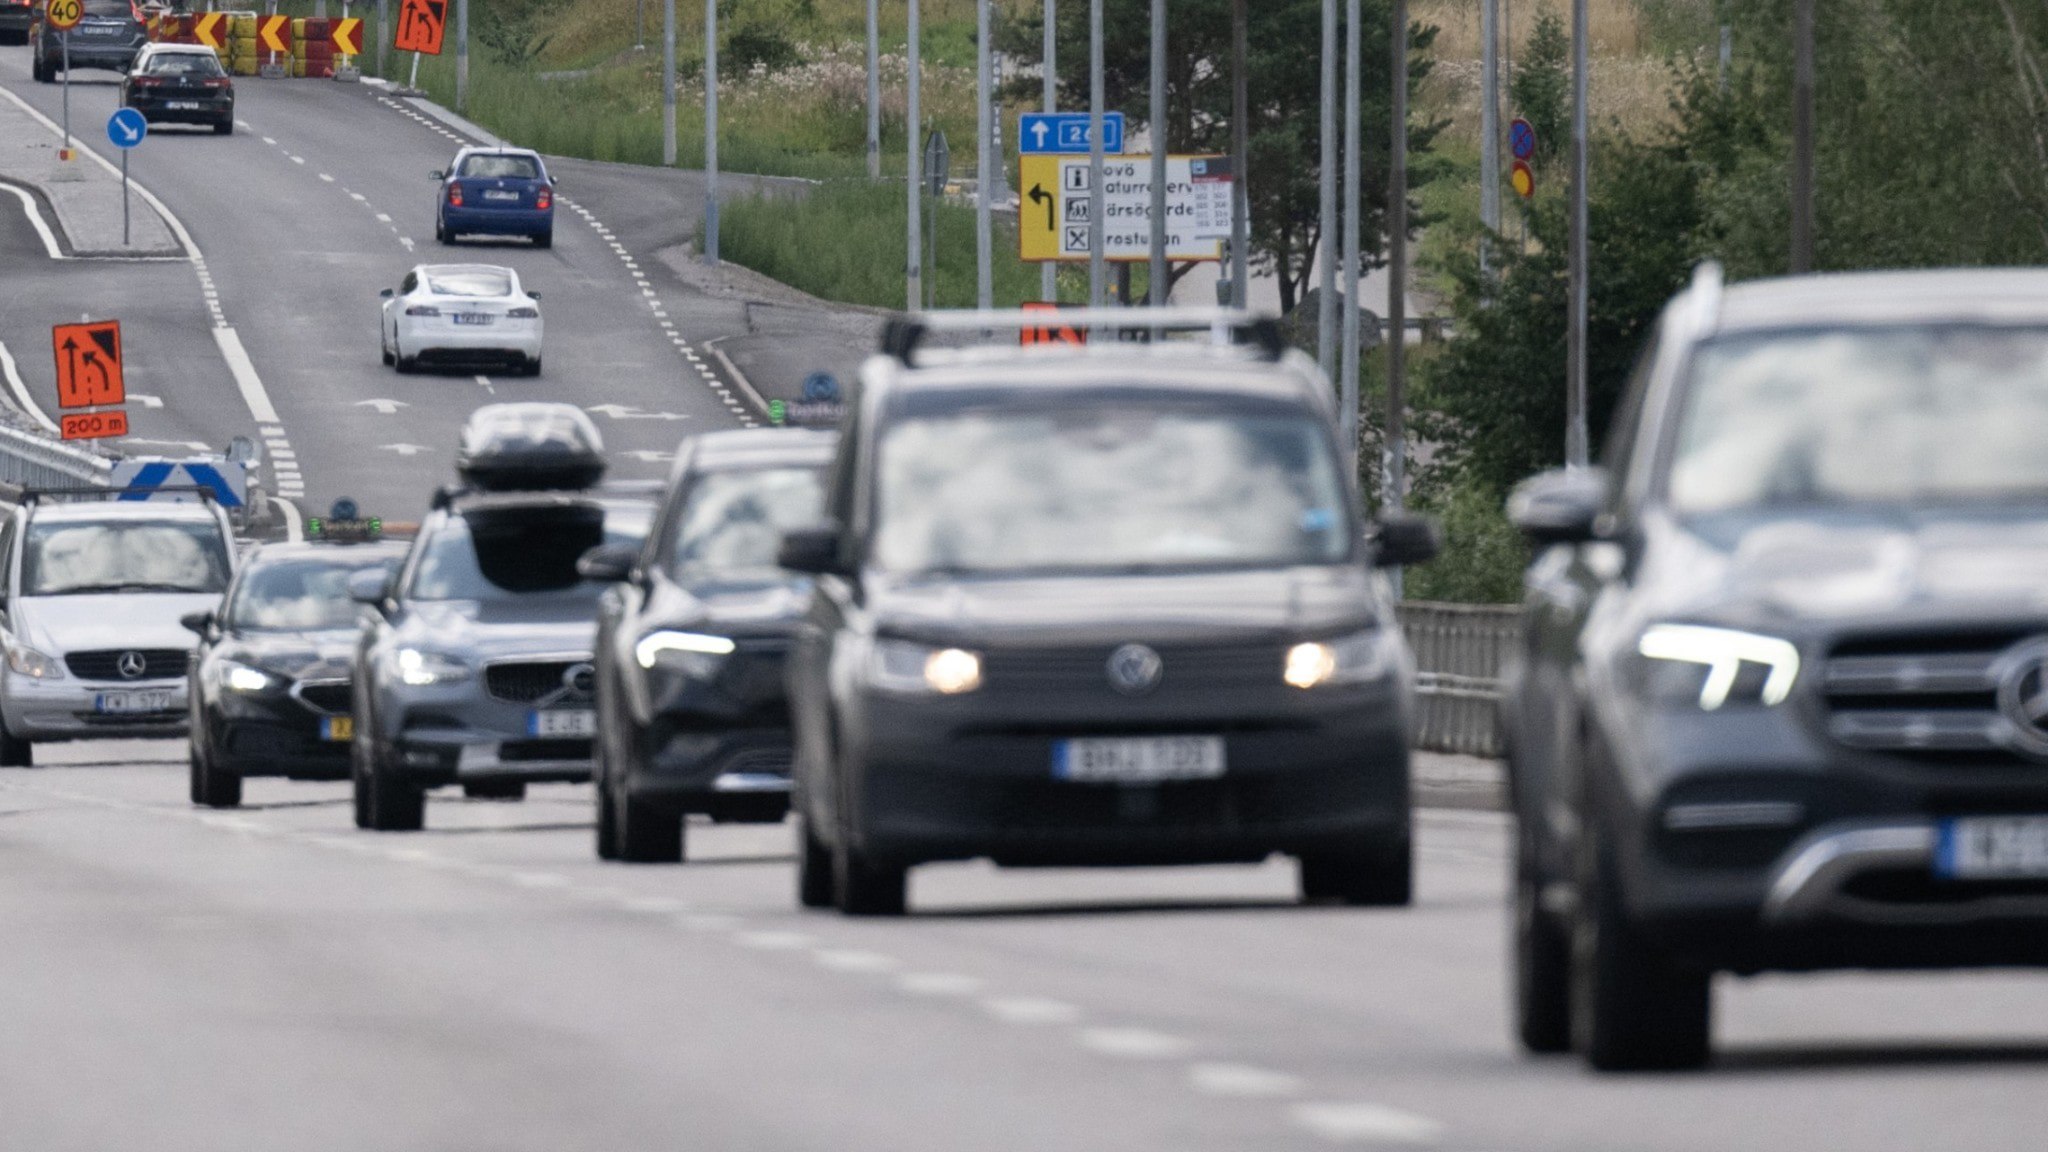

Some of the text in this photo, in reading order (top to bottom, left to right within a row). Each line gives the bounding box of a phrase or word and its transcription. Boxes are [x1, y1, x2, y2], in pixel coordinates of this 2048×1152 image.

[52, 1, 79, 20] 40
[1103, 163, 1135, 176] ovö
[66, 417, 122, 434] 200 m
